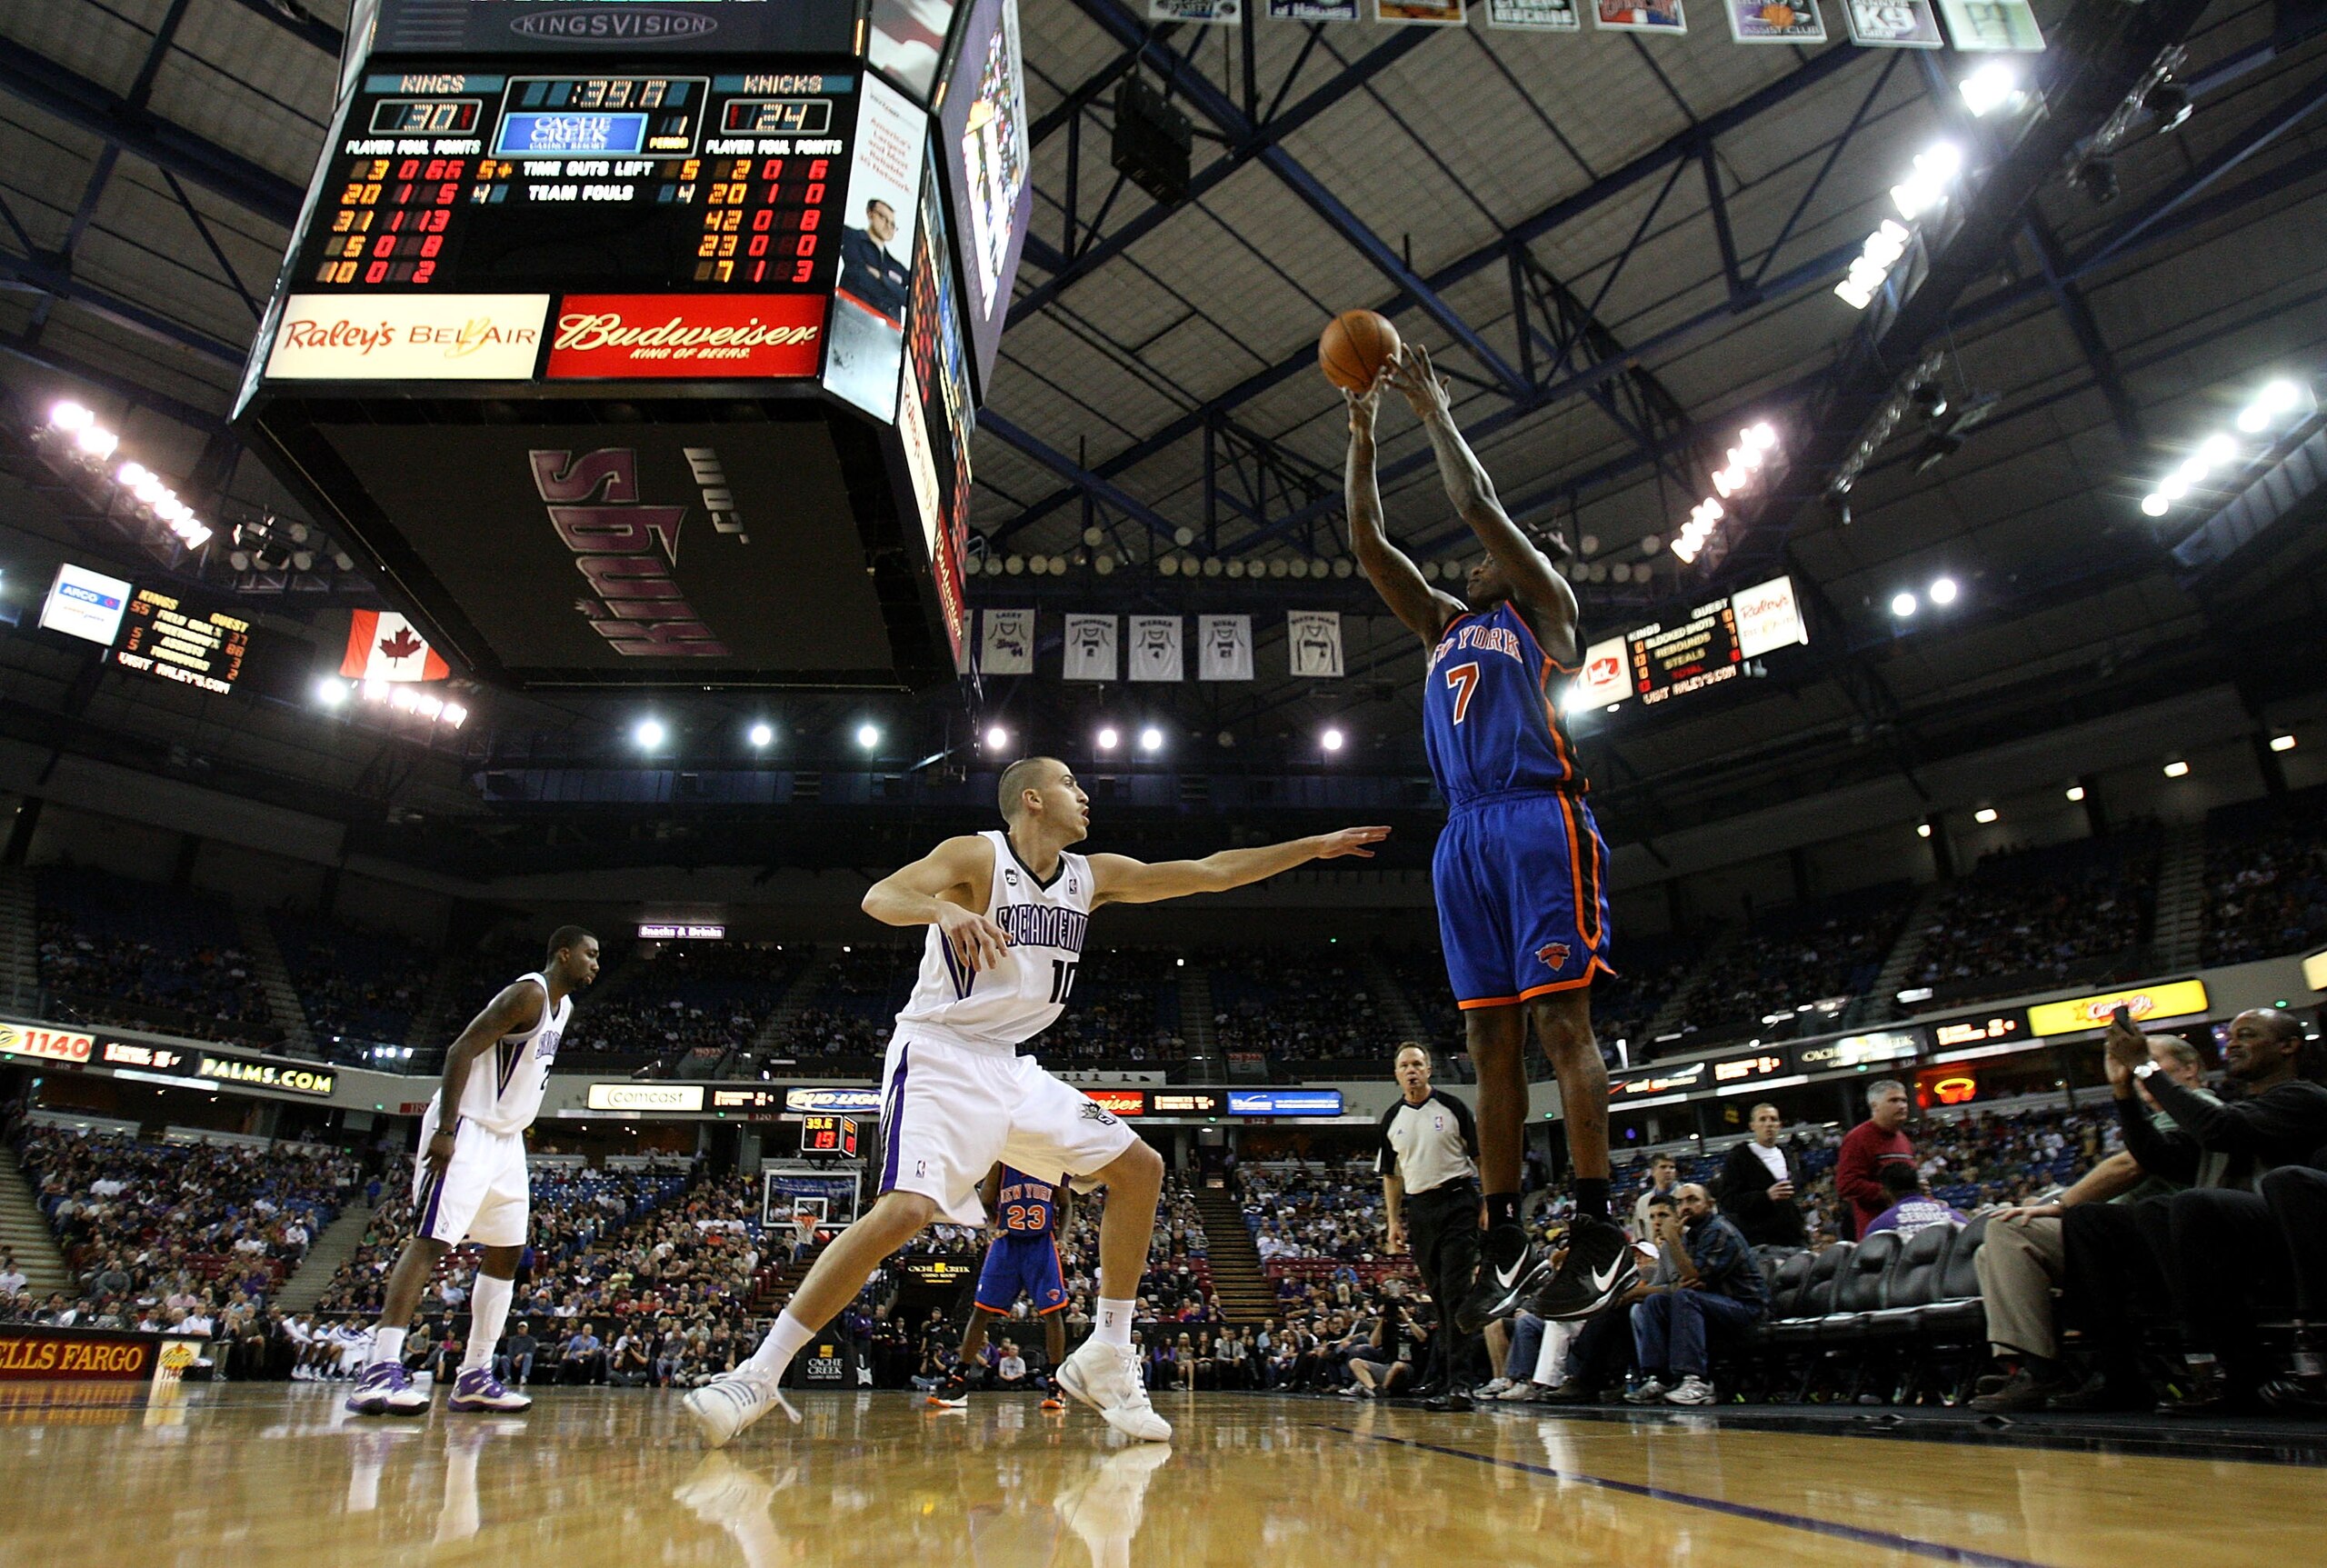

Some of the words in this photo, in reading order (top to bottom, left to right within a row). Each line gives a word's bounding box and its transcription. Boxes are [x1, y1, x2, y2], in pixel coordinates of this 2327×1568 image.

[523, 15, 707, 36] KINGSVISION
[400, 75, 465, 94] KINGS
[744, 75, 823, 94] KNICKS
[404, 104, 458, 131] 30
[534, 116, 612, 131] CACHE
[756, 104, 807, 131] 24
[531, 127, 608, 143] CREEK
[649, 137, 689, 149] PERIOD
[345, 139, 395, 155] PLAYER
[397, 139, 429, 155] FOUL
[434, 139, 482, 155] POINTS
[705, 139, 754, 155] PLAYER
[758, 139, 790, 155] FOUL
[794, 139, 843, 155] POINTS
[367, 159, 390, 180] 3
[398, 159, 420, 180] 0
[523, 161, 562, 176] TIME
[566, 161, 609, 176] OUTS
[614, 161, 654, 176] LEFT
[732, 159, 752, 180] 2
[763, 159, 783, 180] 0
[341, 184, 382, 205] 20
[436, 184, 458, 205] 5
[529, 185, 577, 201] TEAM
[582, 185, 634, 201] FOULS
[708, 184, 747, 205] 20
[804, 184, 825, 205] 0
[333, 210, 375, 232] 31
[419, 210, 451, 232] 13
[705, 210, 743, 231] 42
[753, 210, 773, 231] 0
[344, 235, 366, 257] 5
[373, 235, 396, 257] 0
[698, 235, 738, 256] 23
[749, 235, 769, 256] 0
[796, 235, 817, 256] 0
[326, 261, 358, 283] 10
[365, 261, 389, 283] 0
[412, 261, 436, 283] 2
[718, 260, 734, 283] 7
[793, 260, 814, 283] 3
[284, 319, 395, 355] Raley's
[554, 314, 817, 350] Budweiser
[630, 347, 672, 359] KING
[673, 347, 698, 359] OF
[64, 585, 98, 603] ARCO
[138, 589, 179, 610] KINGS
[130, 601, 151, 616] 55
[157, 609, 187, 626] FIELD
[1691, 597, 1729, 620] GUEST
[1740, 594, 1790, 621] Raley's
[210, 612, 249, 634] GUEST
[1627, 623, 1662, 644] KINGS
[1644, 625, 1686, 650] BLOCKED
[1685, 615, 1716, 635] SHOTS
[1458, 625, 1523, 664] YORK
[1654, 631, 1712, 660] REBOUNDS
[118, 651, 155, 672] VISIT
[1663, 647, 1706, 671] STEALS
[1445, 662, 1480, 725] 7
[641, 925, 675, 935] Snacks
[688, 927, 722, 937] Drinks
[24, 1031, 91, 1058] 1140
[201, 1058, 333, 1093] PALMS.COM
[805, 1117, 834, 1130] 39.6
[1001, 1183, 1022, 1203] NEW
[1024, 1183, 1053, 1202] YORK
[1007, 1205, 1045, 1230] 23
[0, 1342, 56, 1371] ELLS
[58, 1343, 144, 1372] FARGO
[807, 1357, 844, 1367] CACHE
[806, 1366, 843, 1375] CREEK
